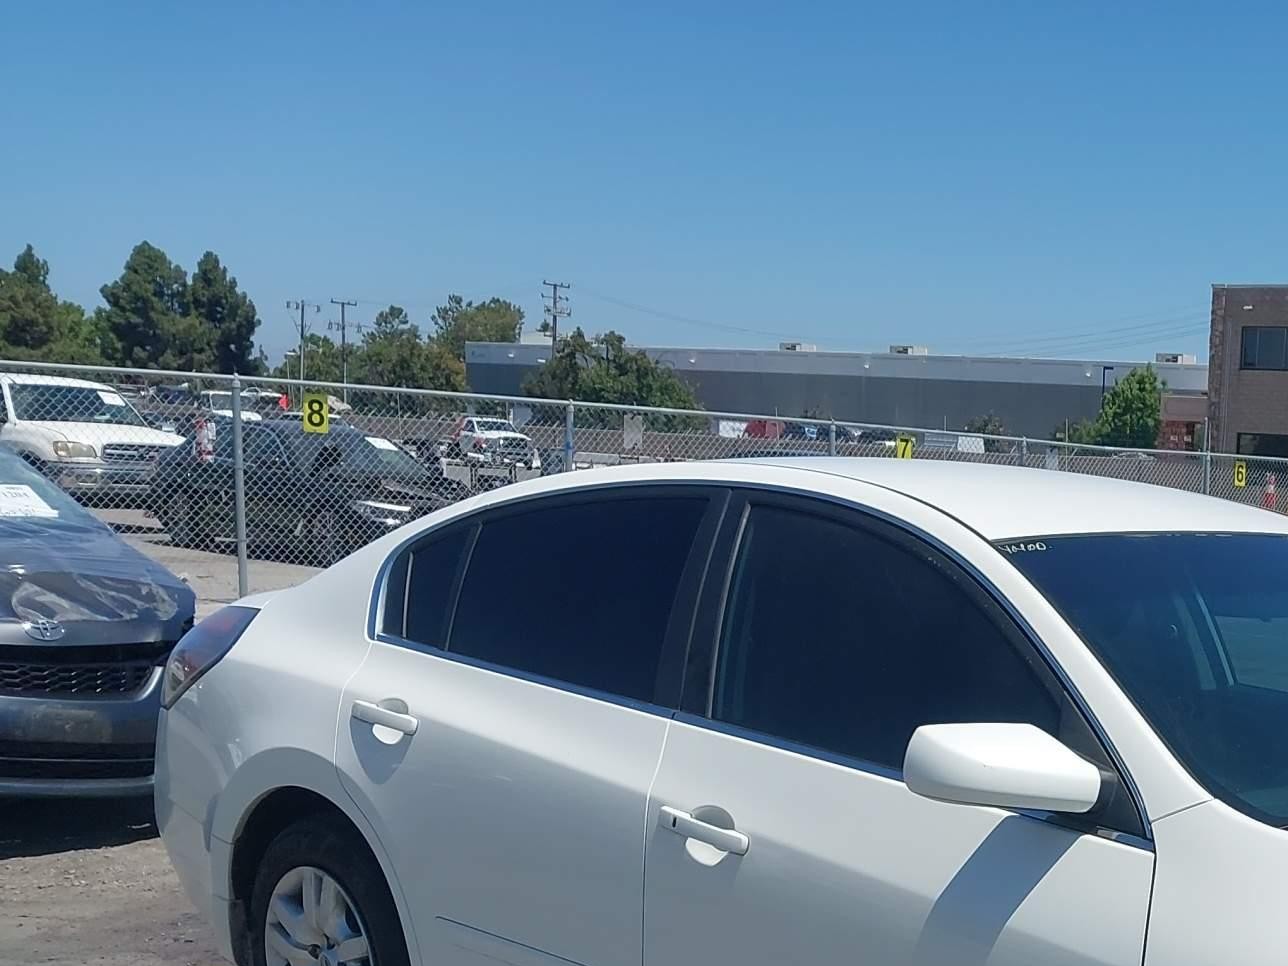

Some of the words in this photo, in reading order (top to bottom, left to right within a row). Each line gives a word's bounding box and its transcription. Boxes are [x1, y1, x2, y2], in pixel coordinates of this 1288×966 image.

[307, 398, 325, 428] 8
[900, 438, 910, 458] 7
[1236, 464, 1244, 483] 6
